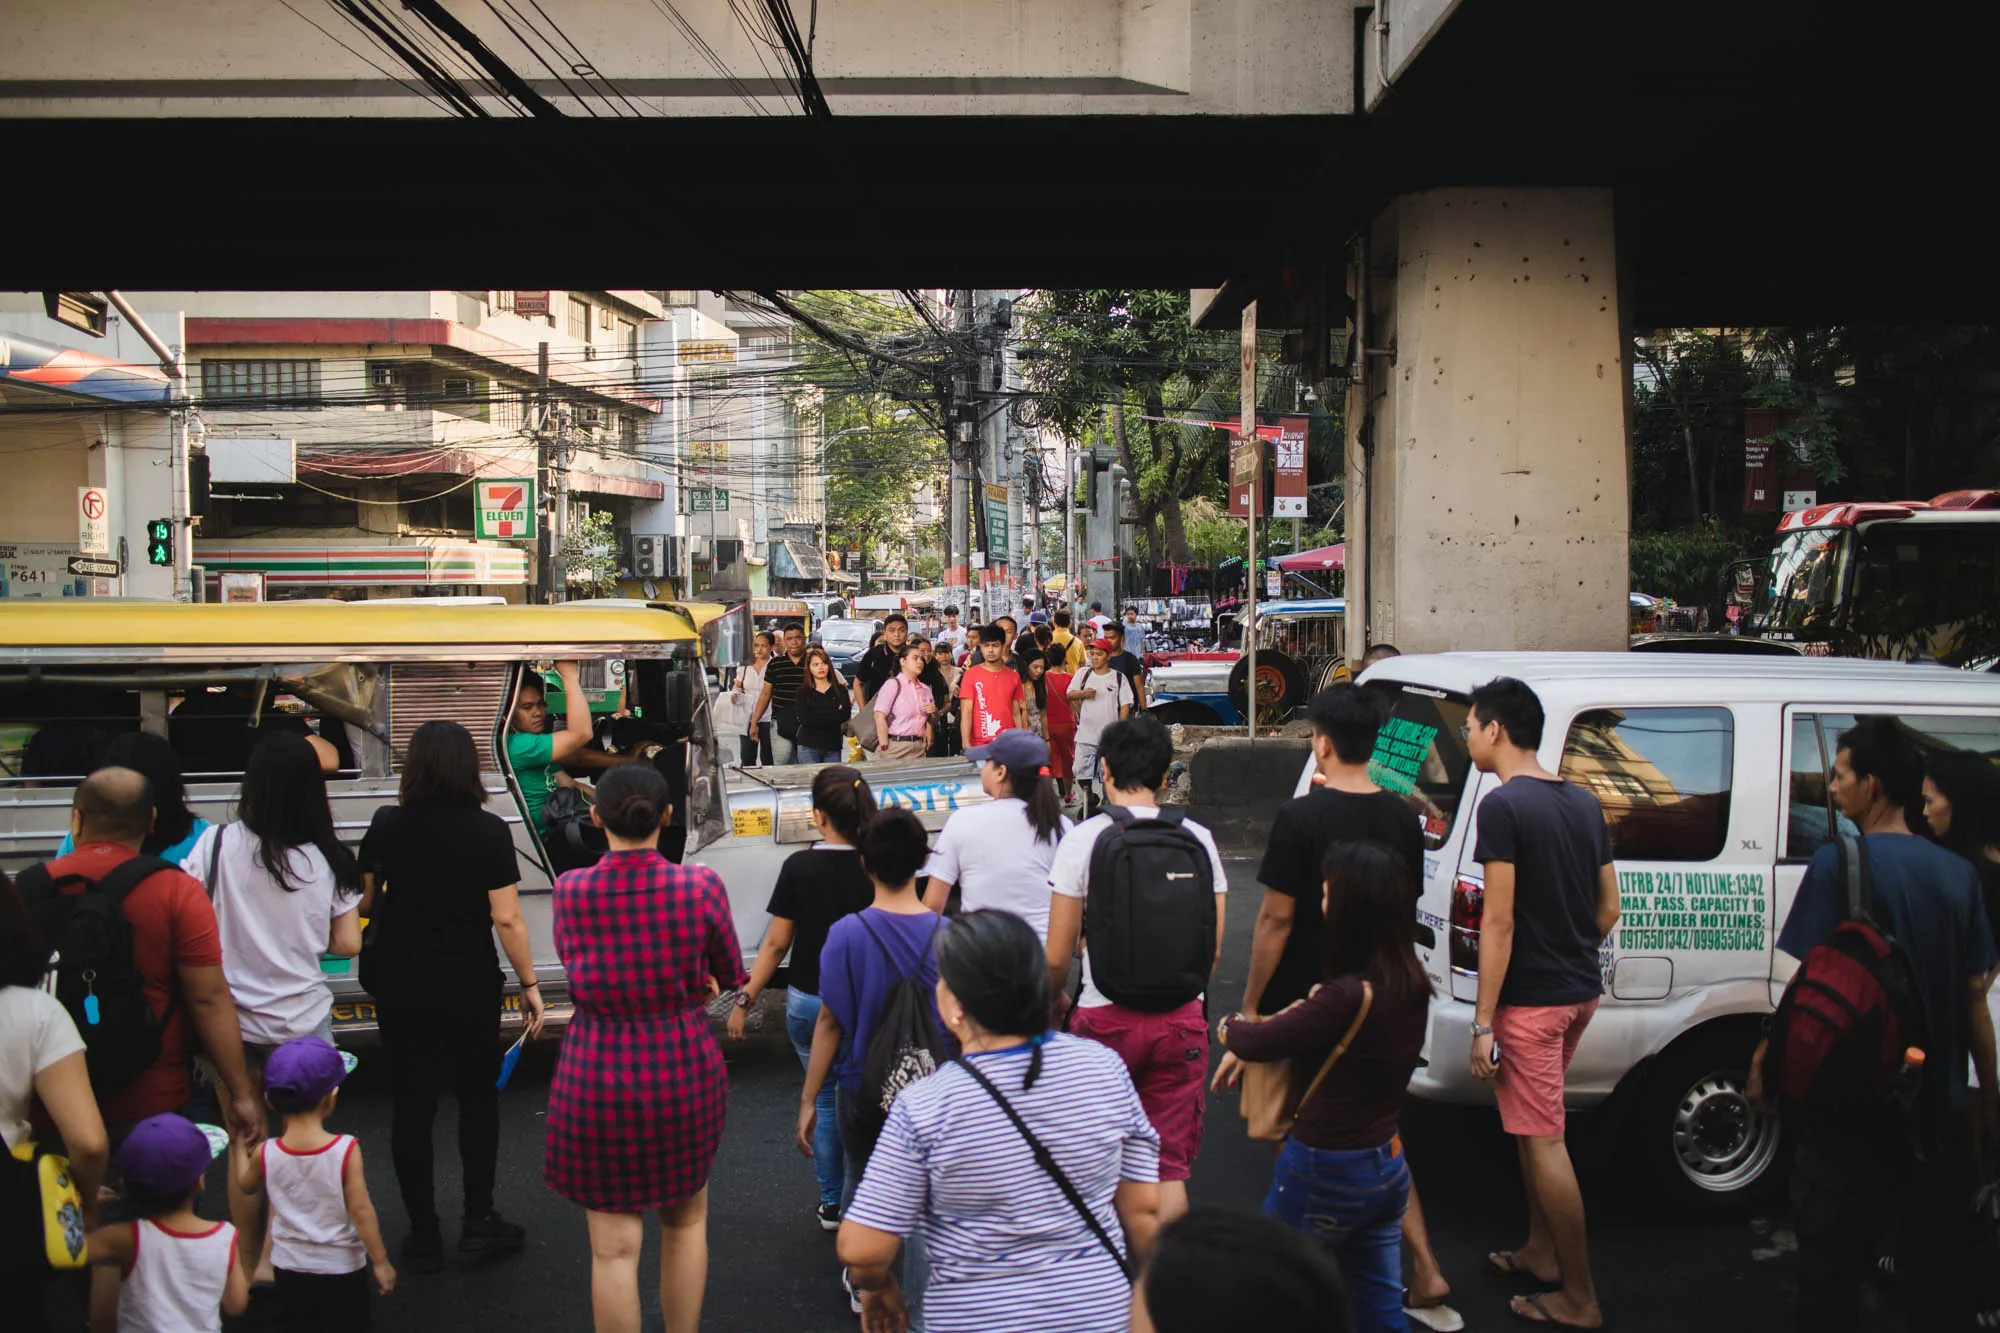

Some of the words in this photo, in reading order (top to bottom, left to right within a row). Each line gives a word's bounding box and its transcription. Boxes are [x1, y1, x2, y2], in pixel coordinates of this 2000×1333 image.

[84, 542, 105, 550] TURN
[75, 562, 96, 571] ONE
[96, 564, 116, 573] WAY
[1740, 839, 1763, 850] XL
[1619, 871, 1655, 894] LTFRB
[1656, 872, 1683, 895] 24/7
[1685, 872, 1765, 896] HOTLINE:1342
[1620, 896, 1651, 911] MAX.
[1654, 896, 1688, 911] PASS.
[1691, 897, 1749, 912] CAPACITY
[1753, 898, 1766, 913] 10
[1423, 911, 1445, 931] HERE
[1622, 912, 1697, 927] TEXT/VIBER
[1700, 914, 1765, 929] HOTLINES:
